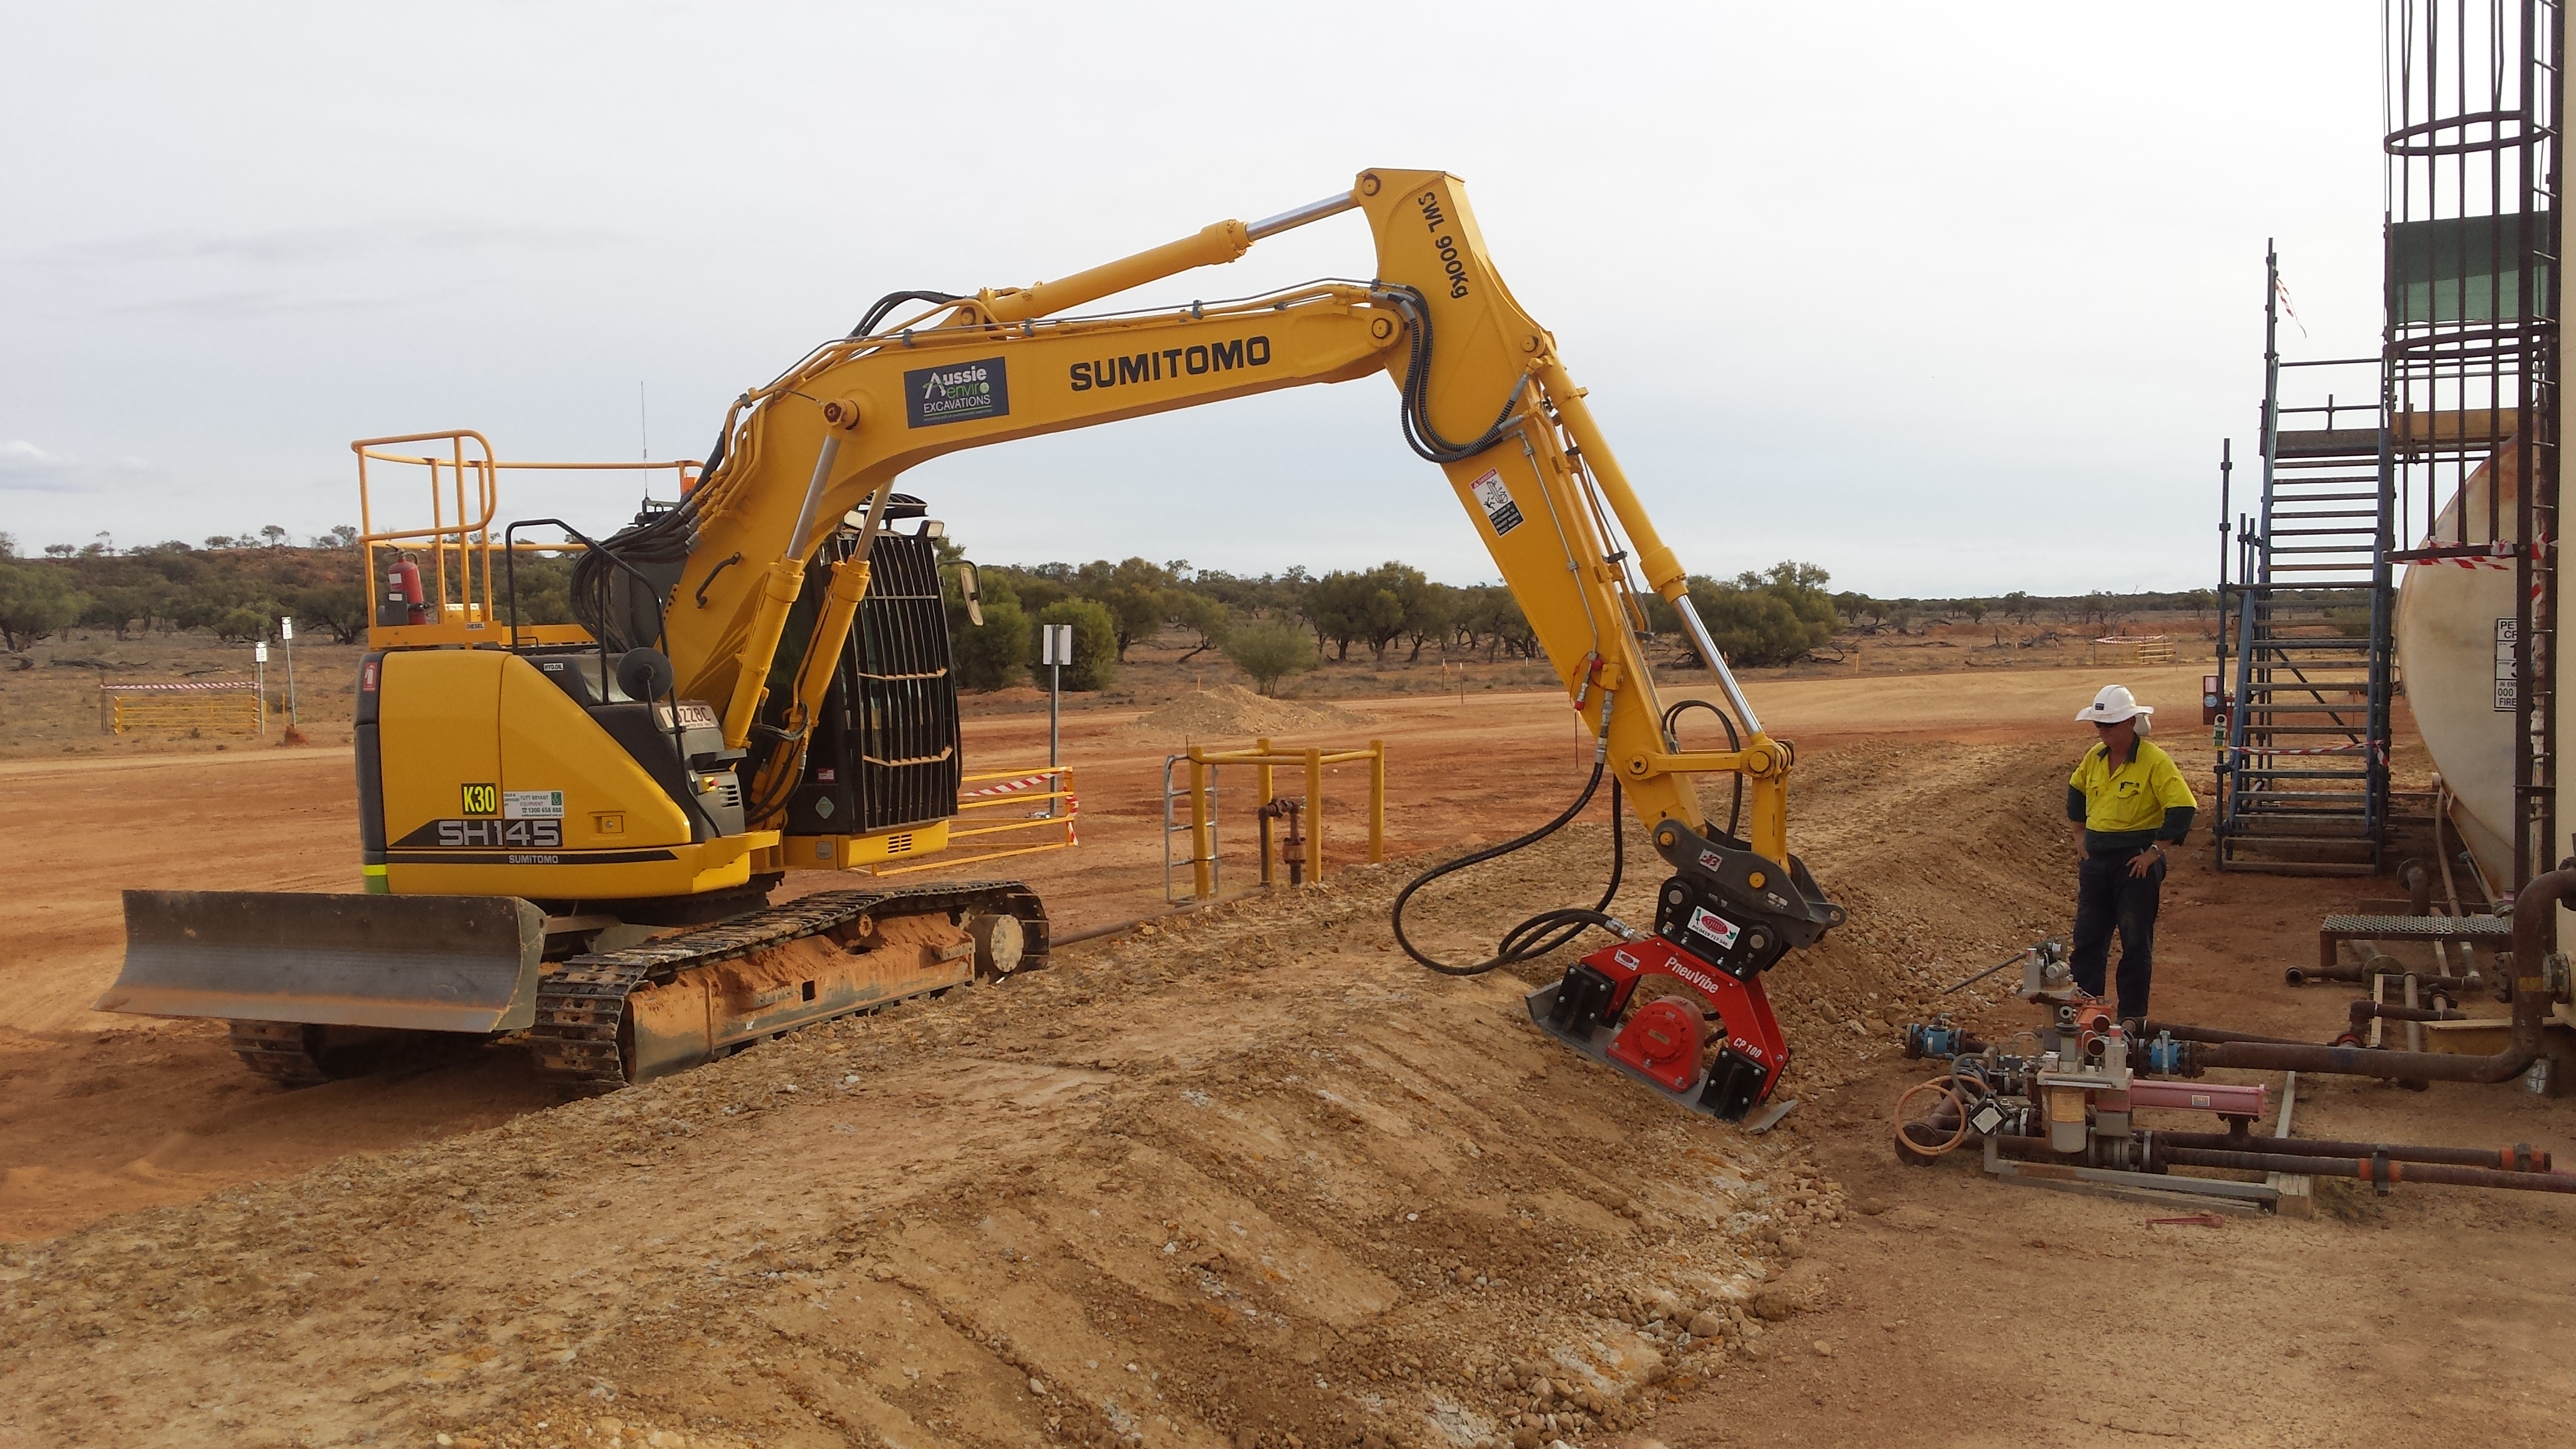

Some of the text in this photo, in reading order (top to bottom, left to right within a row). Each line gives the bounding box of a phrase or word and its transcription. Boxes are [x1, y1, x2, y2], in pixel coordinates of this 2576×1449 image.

[1418, 192, 1469, 300] SWL 900Kg
[1070, 336, 1270, 392] SUMITOMO
[924, 366, 987, 399] Aussie
[924, 394, 991, 413] EXCAVATIONS
[1477, 470, 1495, 484] DANGER
[2498, 688, 2514, 696] 000
[463, 786, 495, 812] K30
[438, 820, 559, 846] SH145
[509, 855, 559, 864] SUMITOMO
[1664, 956, 1719, 993] PneuVibe
[1733, 1037, 1762, 1058] CP 100
